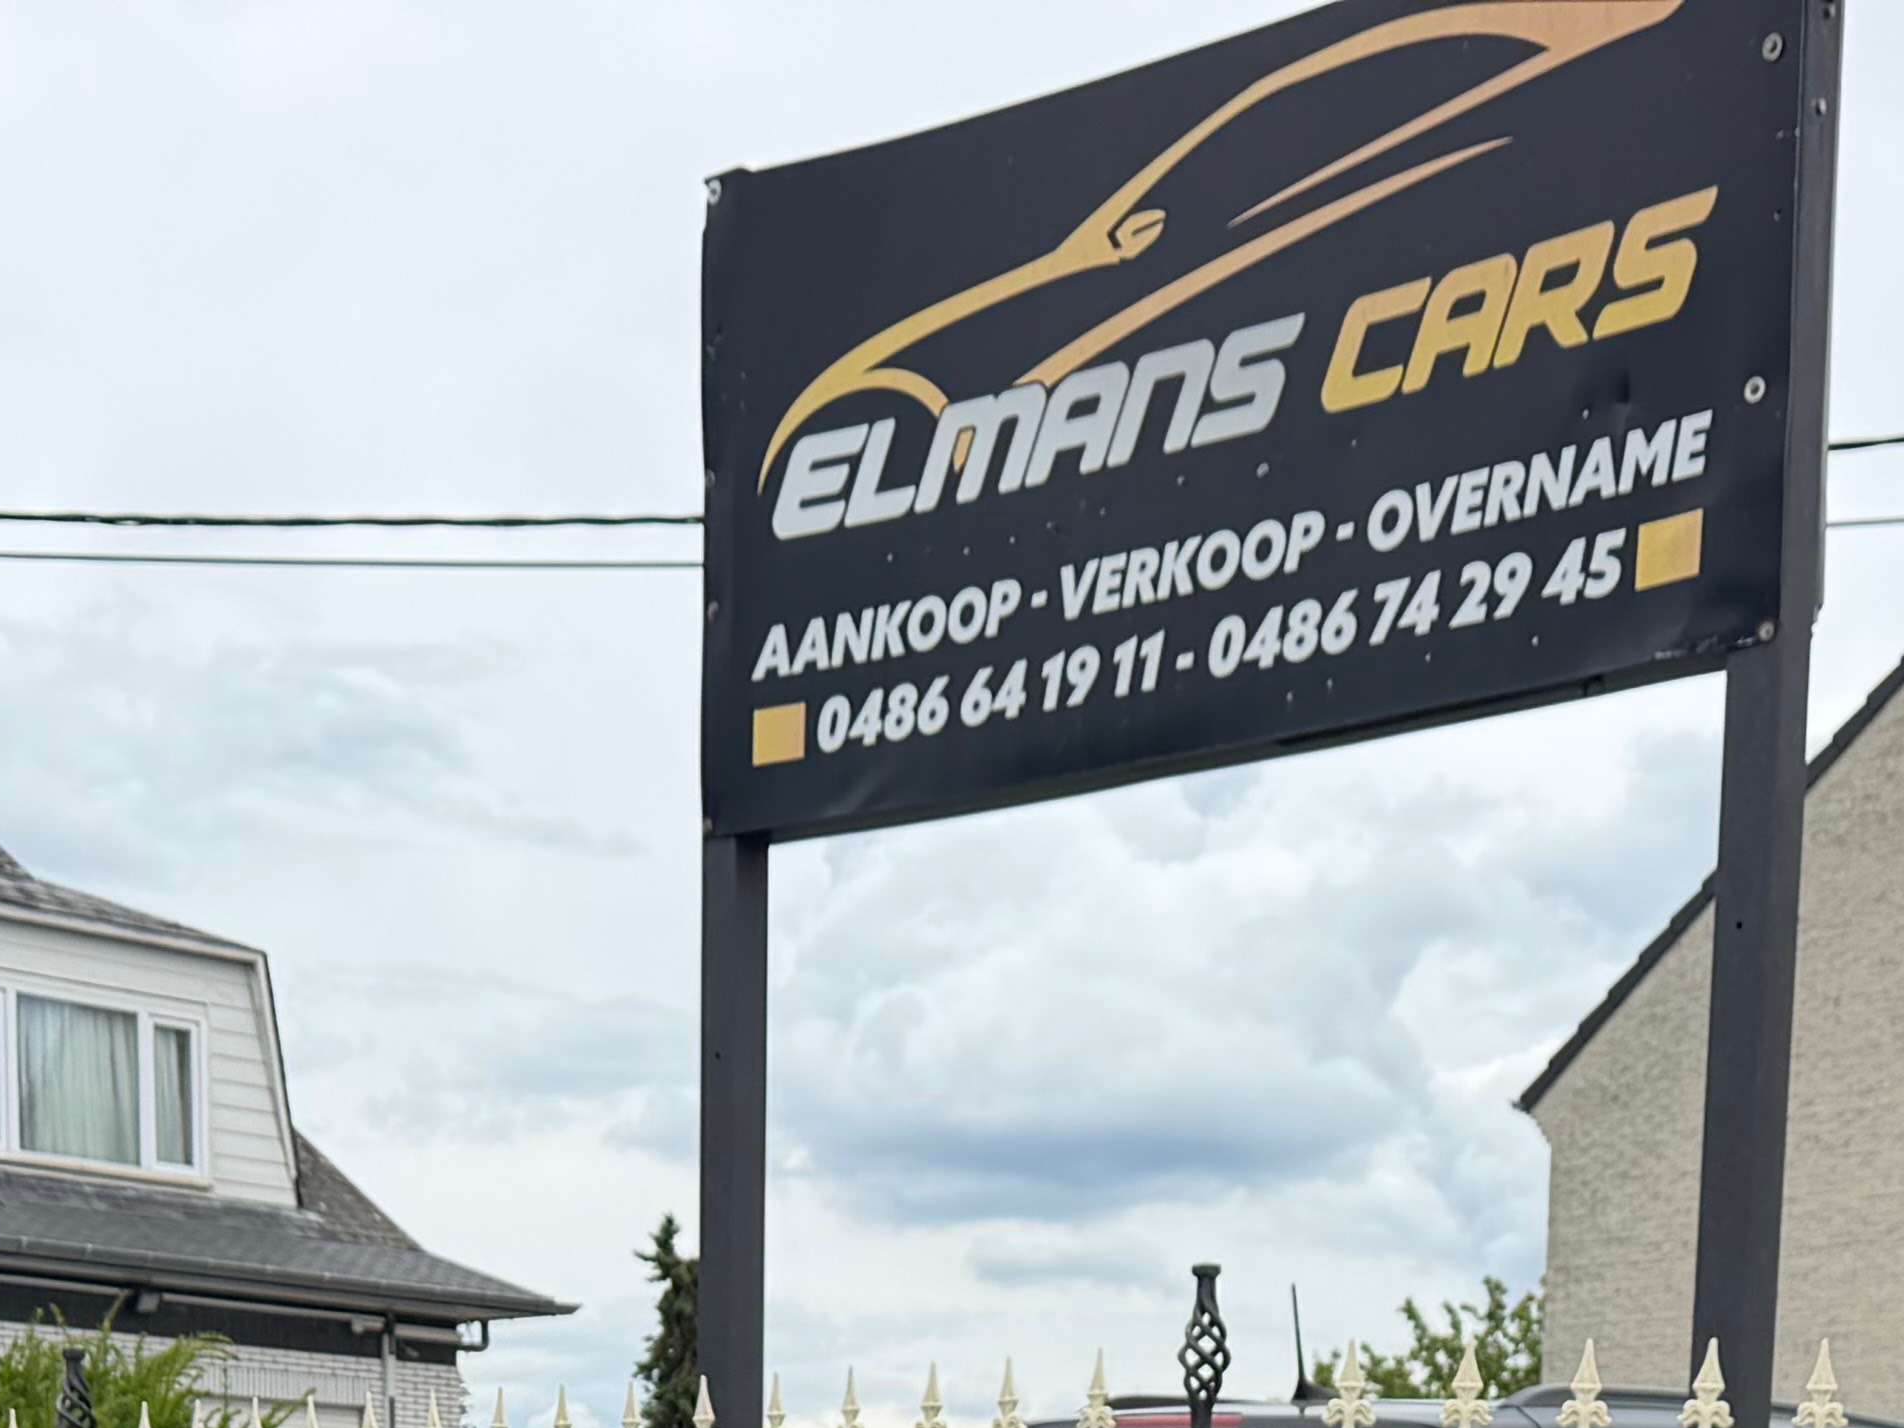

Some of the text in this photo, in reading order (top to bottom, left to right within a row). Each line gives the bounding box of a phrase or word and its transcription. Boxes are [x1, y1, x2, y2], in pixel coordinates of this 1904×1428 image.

[772, 185, 1719, 540] ELMANS CARS
[751, 579, 1022, 681] AANKOOP
[1059, 510, 1326, 620] VERKOOP
[1367, 409, 1712, 552] OVERNAME
[816, 676, 949, 753] 0486
[960, 659, 1028, 728] 64
[1041, 645, 1100, 711] 19
[1113, 629, 1165, 698] 11
[1208, 589, 1359, 679] 0486
[1369, 570, 1442, 646] 74
[1449, 551, 1533, 629] 29
[1542, 528, 1626, 605] 45
